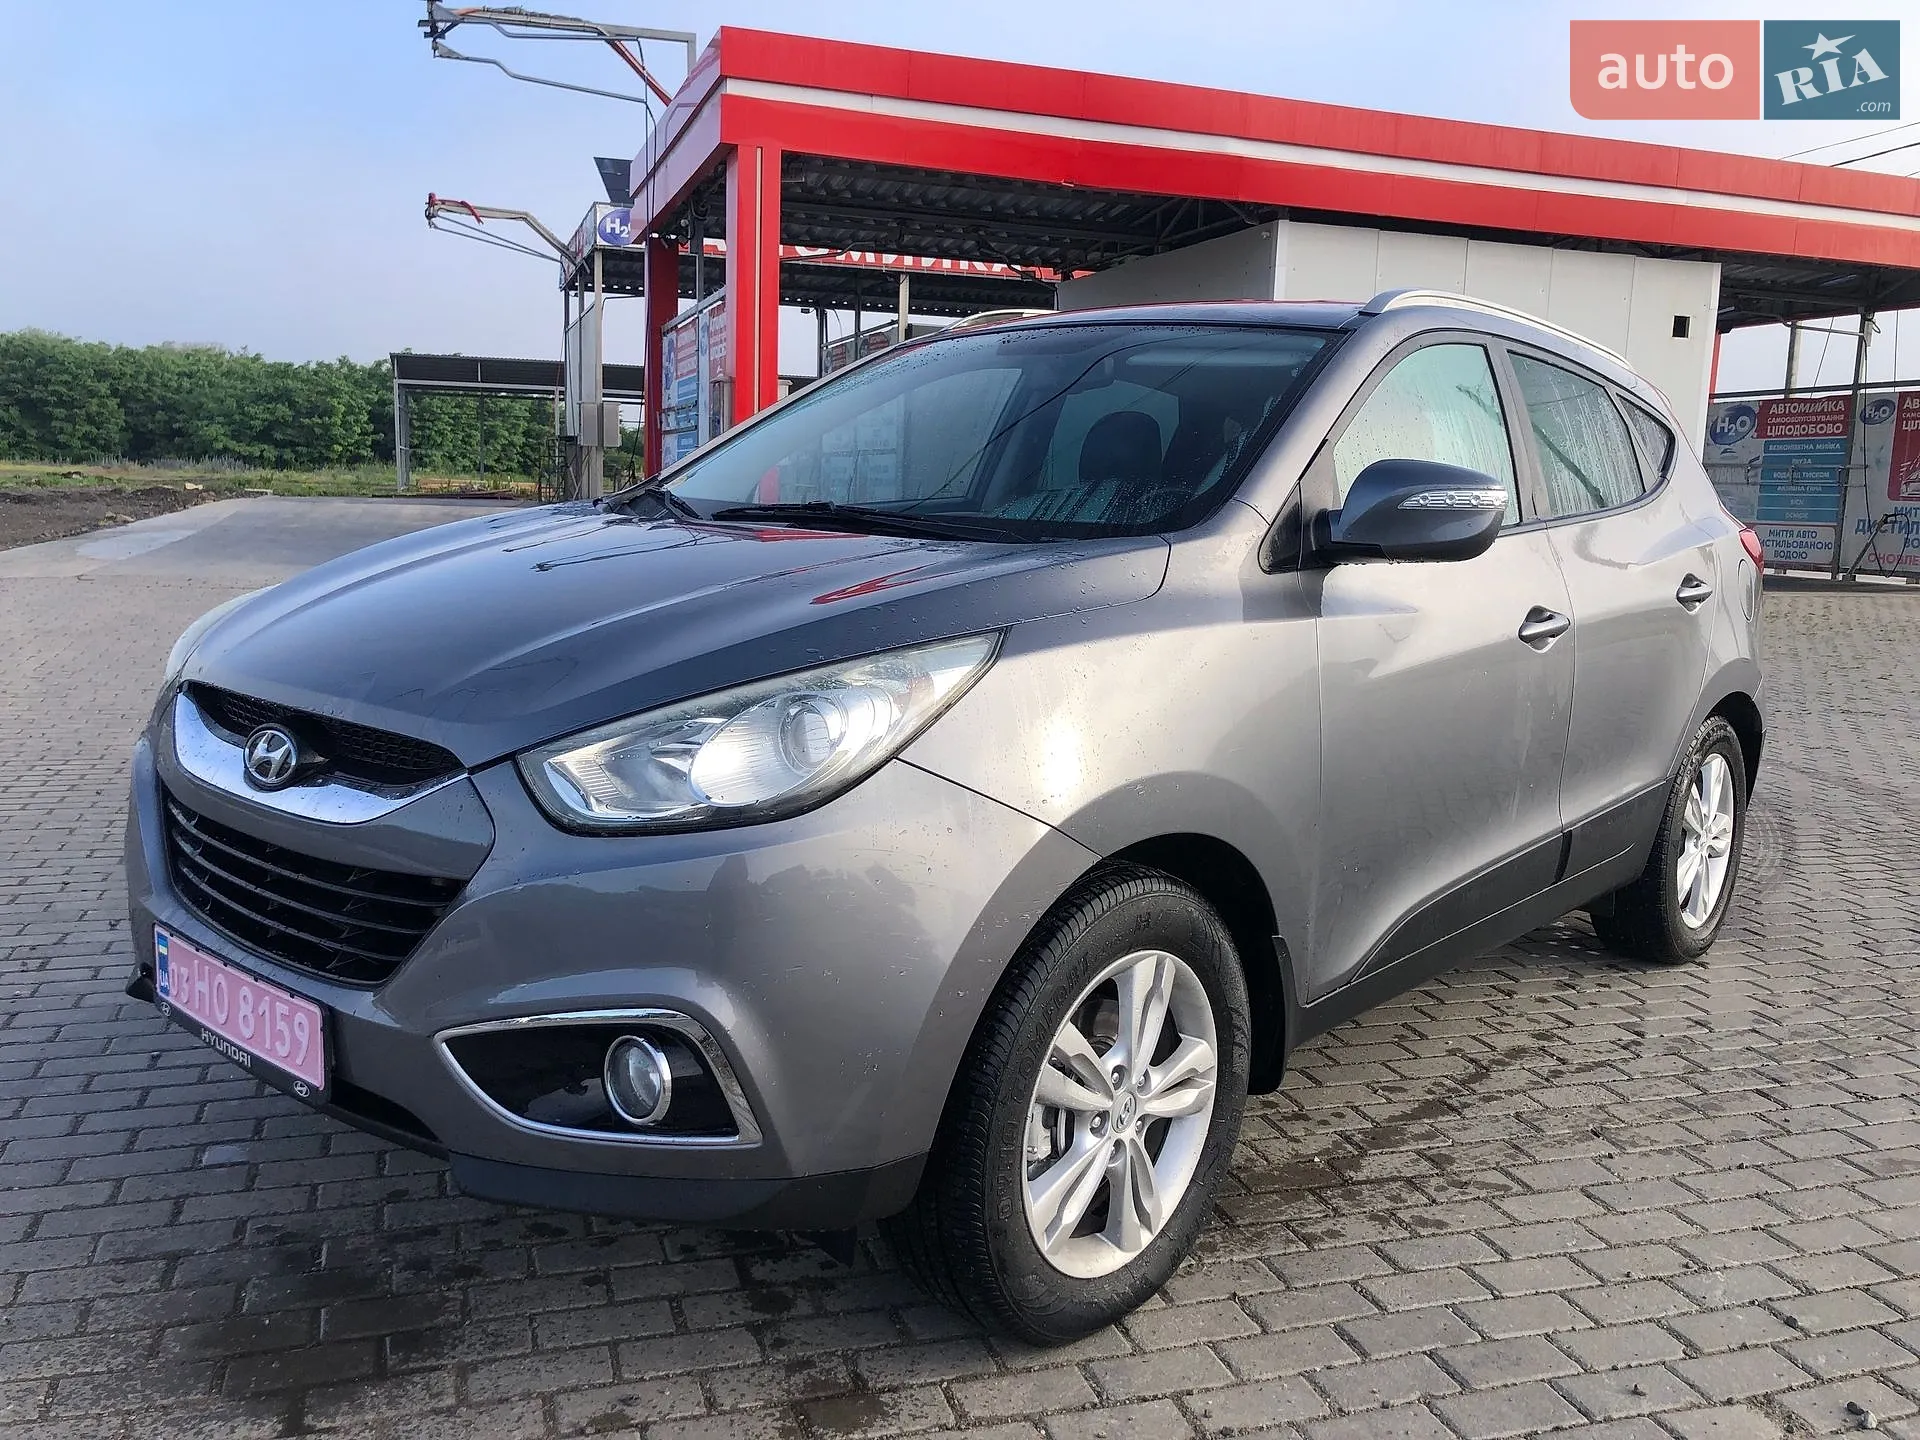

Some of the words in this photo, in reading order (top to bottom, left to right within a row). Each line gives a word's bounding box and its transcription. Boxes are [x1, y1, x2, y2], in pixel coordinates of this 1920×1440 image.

[605, 218, 631, 238] H2
[1769, 399, 1845, 415] АВТОМИЙКА
[1903, 397, 1920, 409] АВ
[1767, 423, 1843, 437] ЦІЛОДОБОВО
[1768, 529, 1795, 539] МИТТЯ
[1796, 530, 1818, 539] АВТО
[1759, 539, 1833, 550] ИСТИЛЬОВАНОЮ
[1773, 550, 1808, 560] ВОДОЮ
[238, 985, 309, 1066] 8159
[201, 1028, 251, 1067] HYUNDAI
